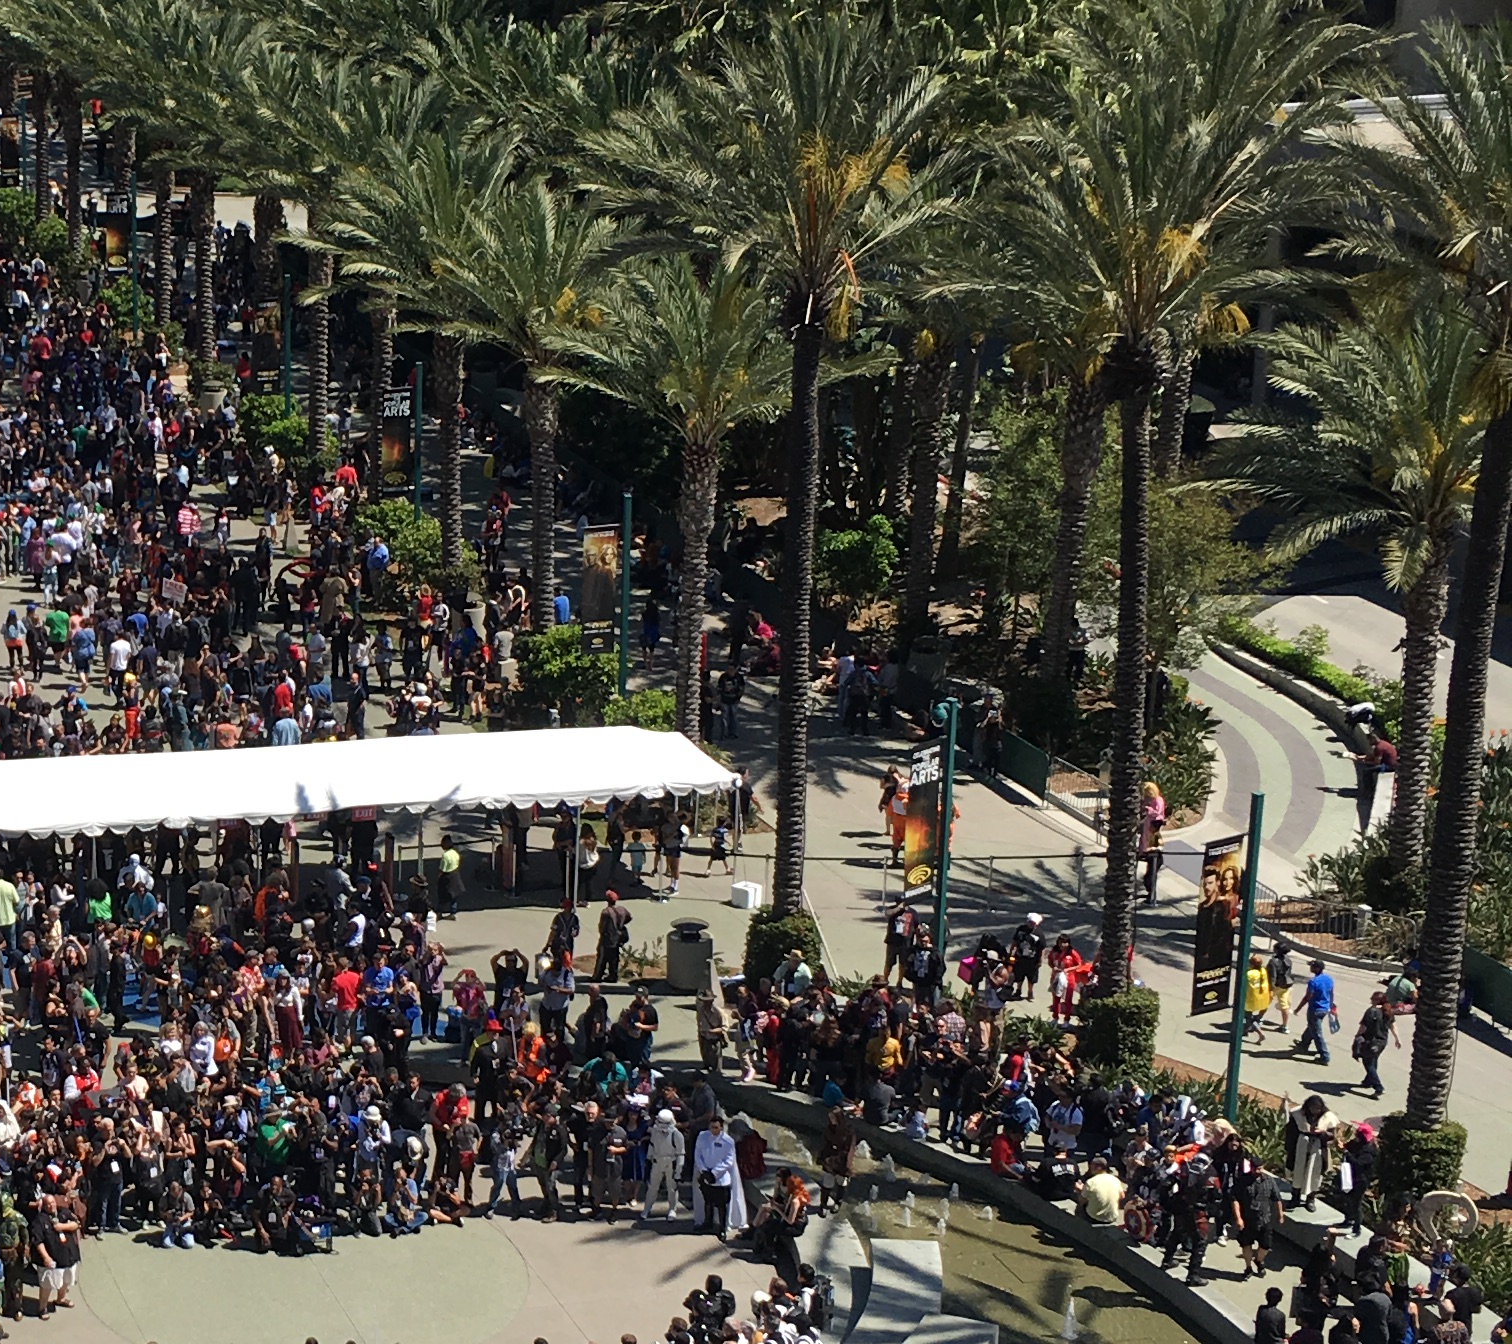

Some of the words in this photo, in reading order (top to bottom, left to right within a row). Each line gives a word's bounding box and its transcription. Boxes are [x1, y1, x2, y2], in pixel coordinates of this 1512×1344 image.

[384, 406, 411, 417] ARTS
[910, 765, 939, 786] ARTS
[354, 809, 374, 818] EXIT
